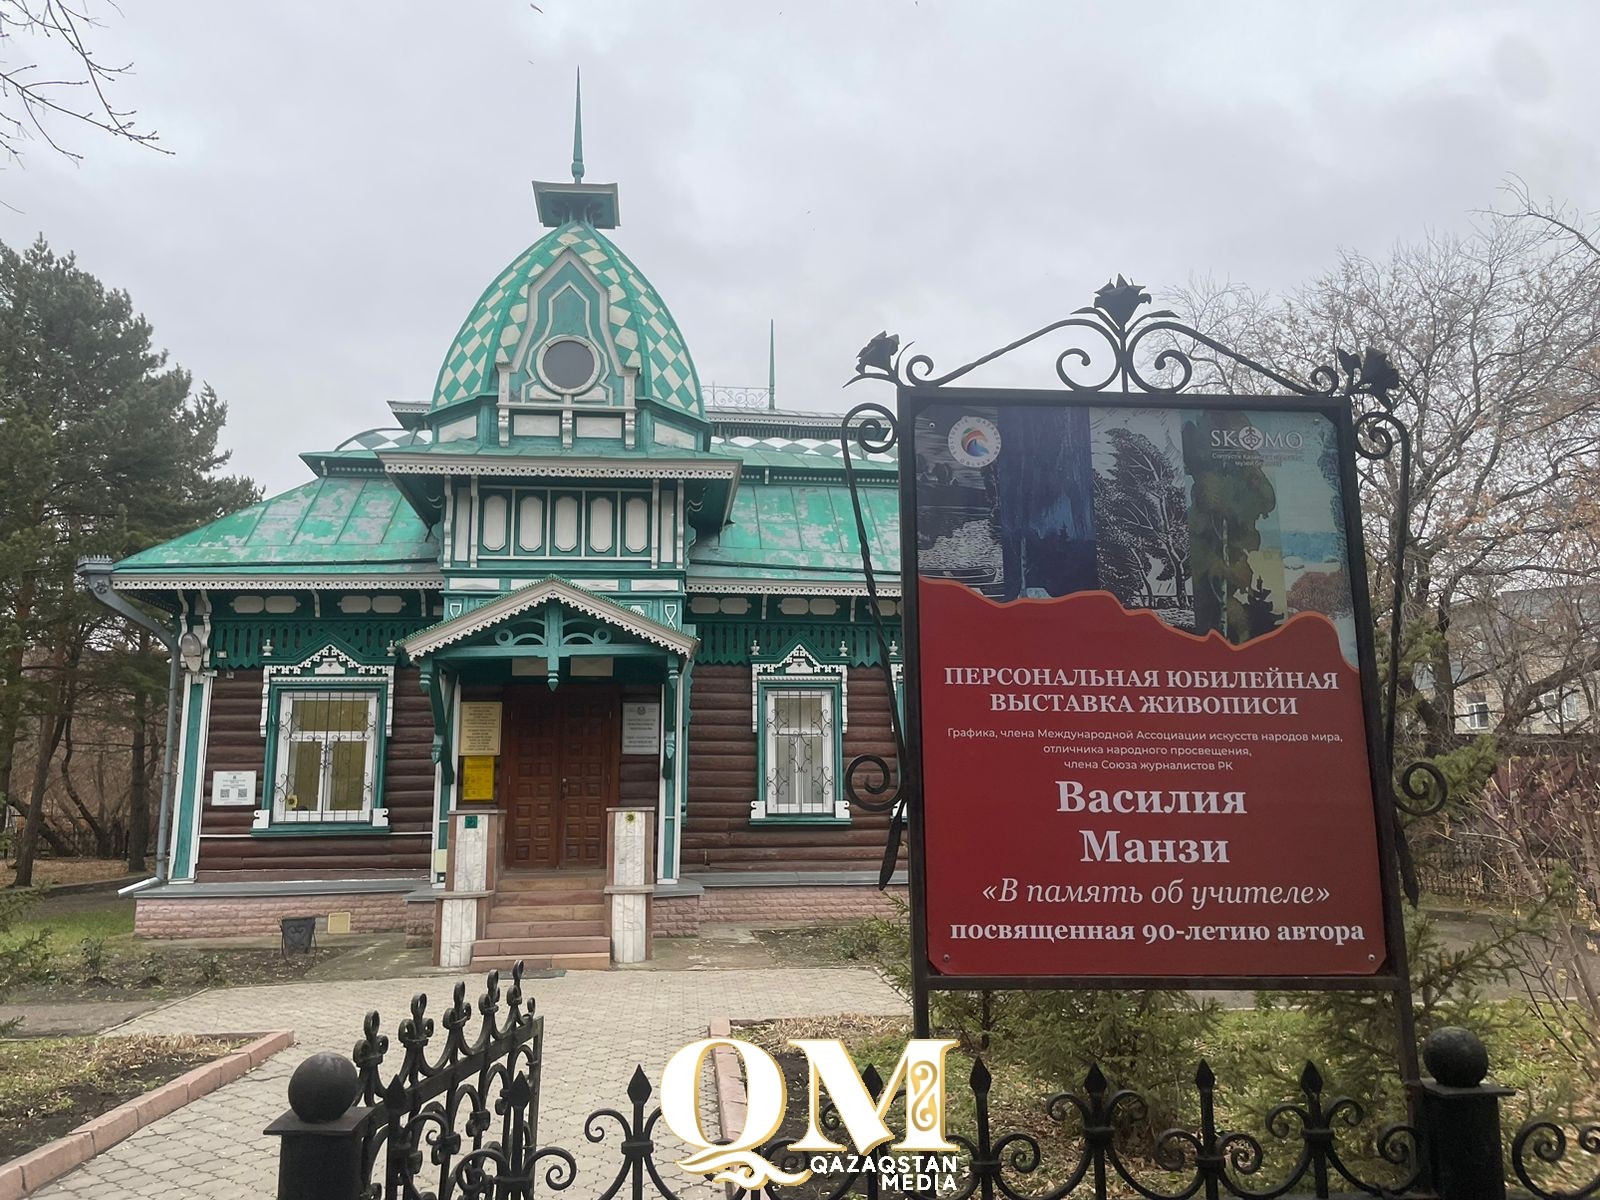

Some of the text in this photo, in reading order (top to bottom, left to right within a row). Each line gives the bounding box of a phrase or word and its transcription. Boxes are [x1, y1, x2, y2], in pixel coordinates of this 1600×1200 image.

[944, 667, 1339, 689] ПЕРСОНАЛЬНАЯ ЮБИЛЕЙНАЯ
[990, 694, 1298, 714] ВЫСТАВКА ЖИВОПИСИ
[947, 727, 1343, 744] Графика, члена Международной Ассоциации искусств народов мира,
[1043, 745, 1252, 757] отличника народного просвещения,
[1063, 759, 1234, 772] члена Союза журналистов РК
[1055, 781, 1247, 813] Василия
[1079, 830, 1230, 863] Манзи
[983, 878, 1329, 910] «В память об учителе»
[950, 925, 1365, 945] посвященная 90-летию автора
